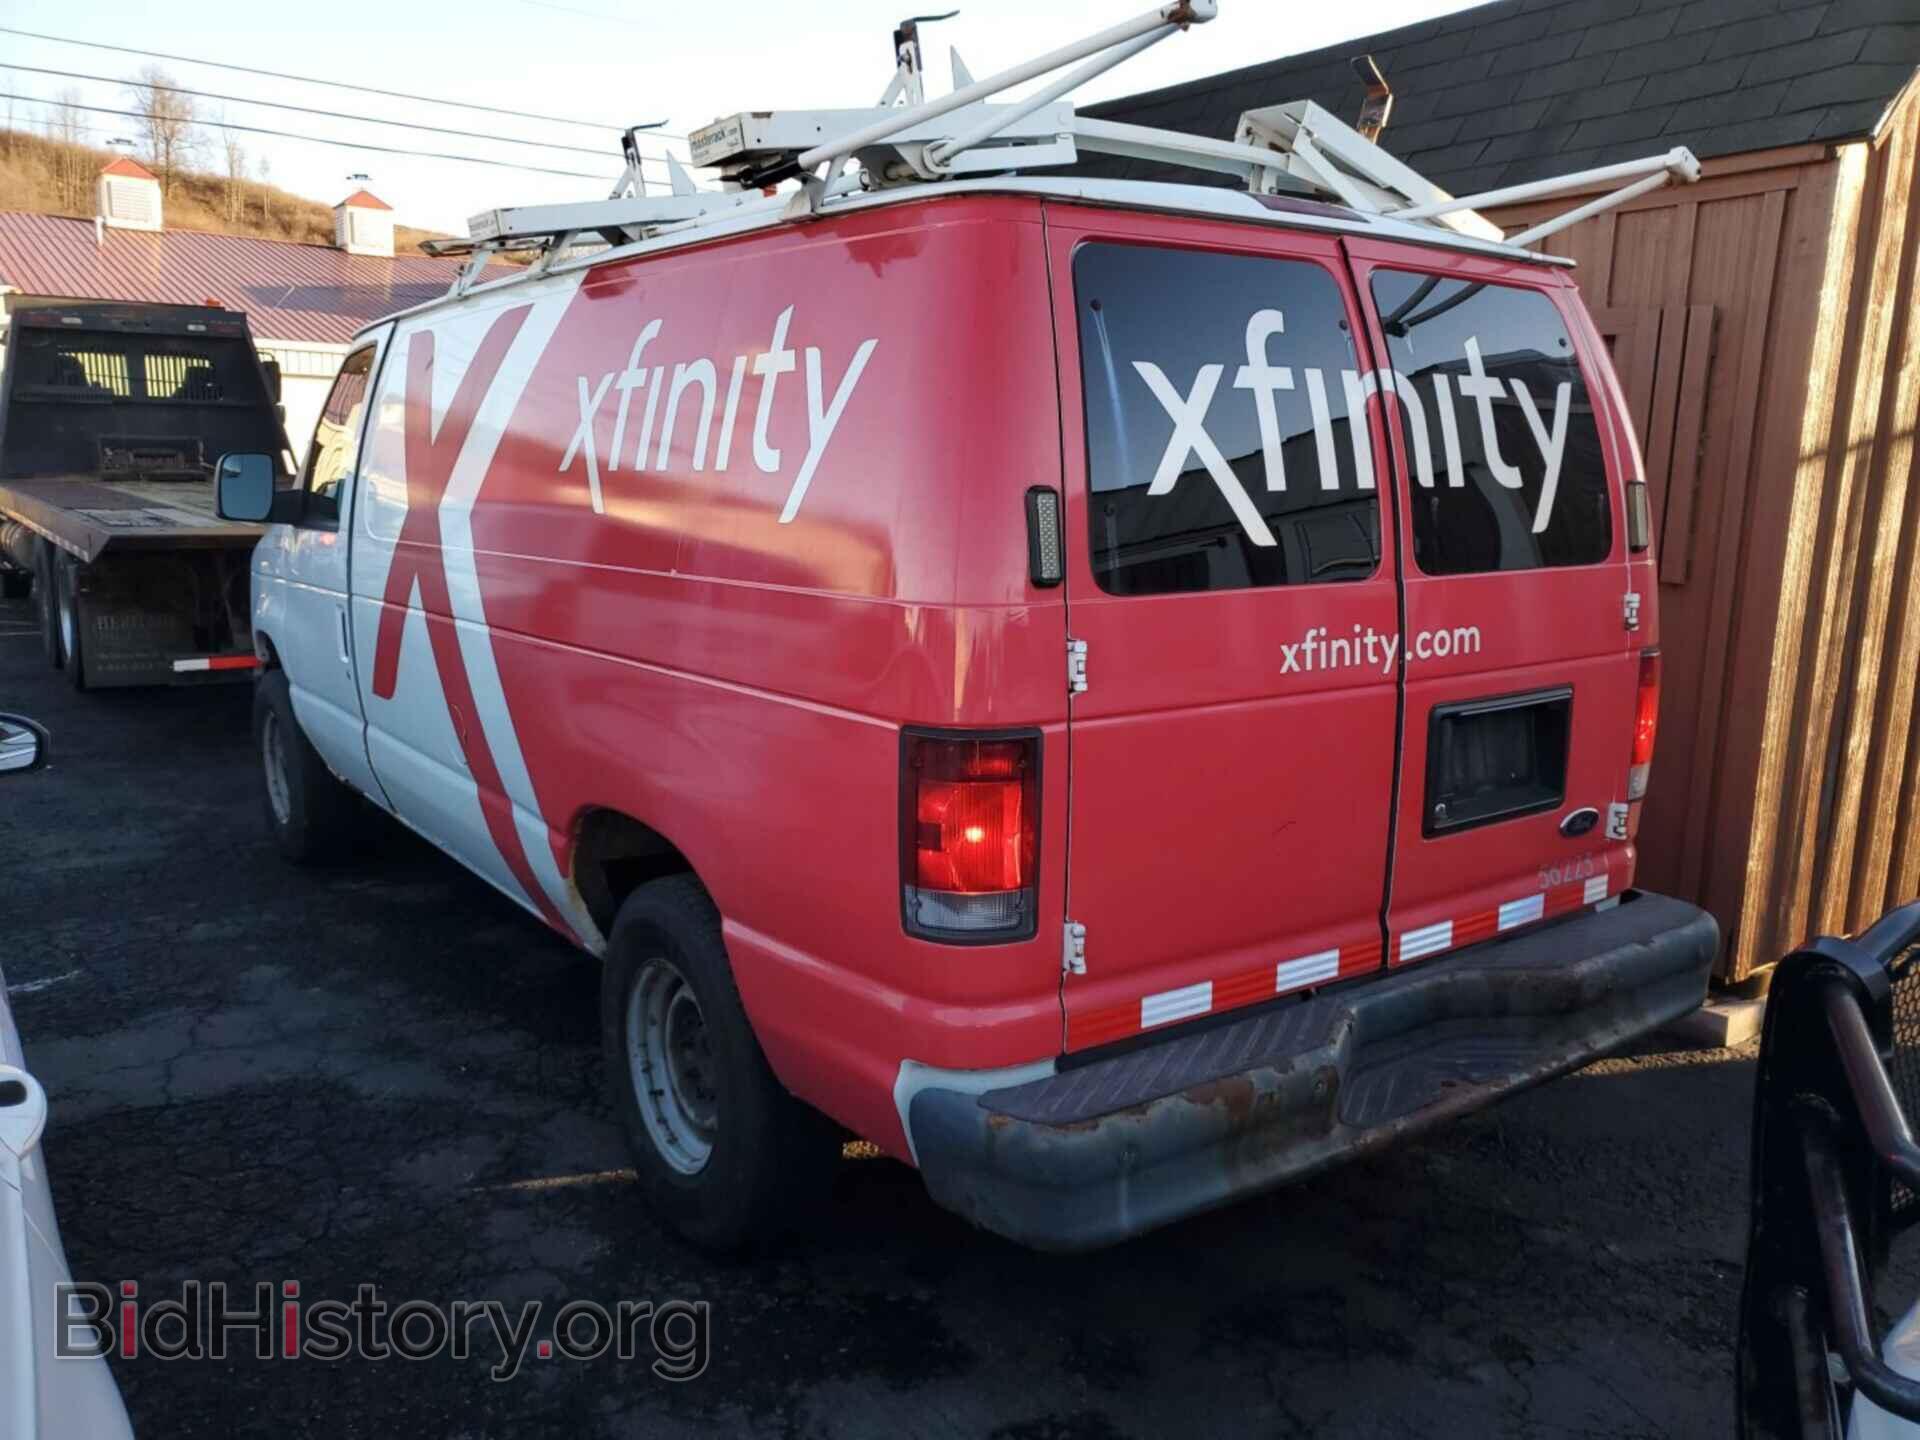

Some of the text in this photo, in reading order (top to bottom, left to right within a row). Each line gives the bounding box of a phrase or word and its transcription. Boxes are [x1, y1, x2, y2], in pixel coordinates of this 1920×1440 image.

[558, 304, 878, 523] xfinity
[1131, 309, 1571, 546] xfinity
[1280, 624, 1480, 674] xfinity.com
